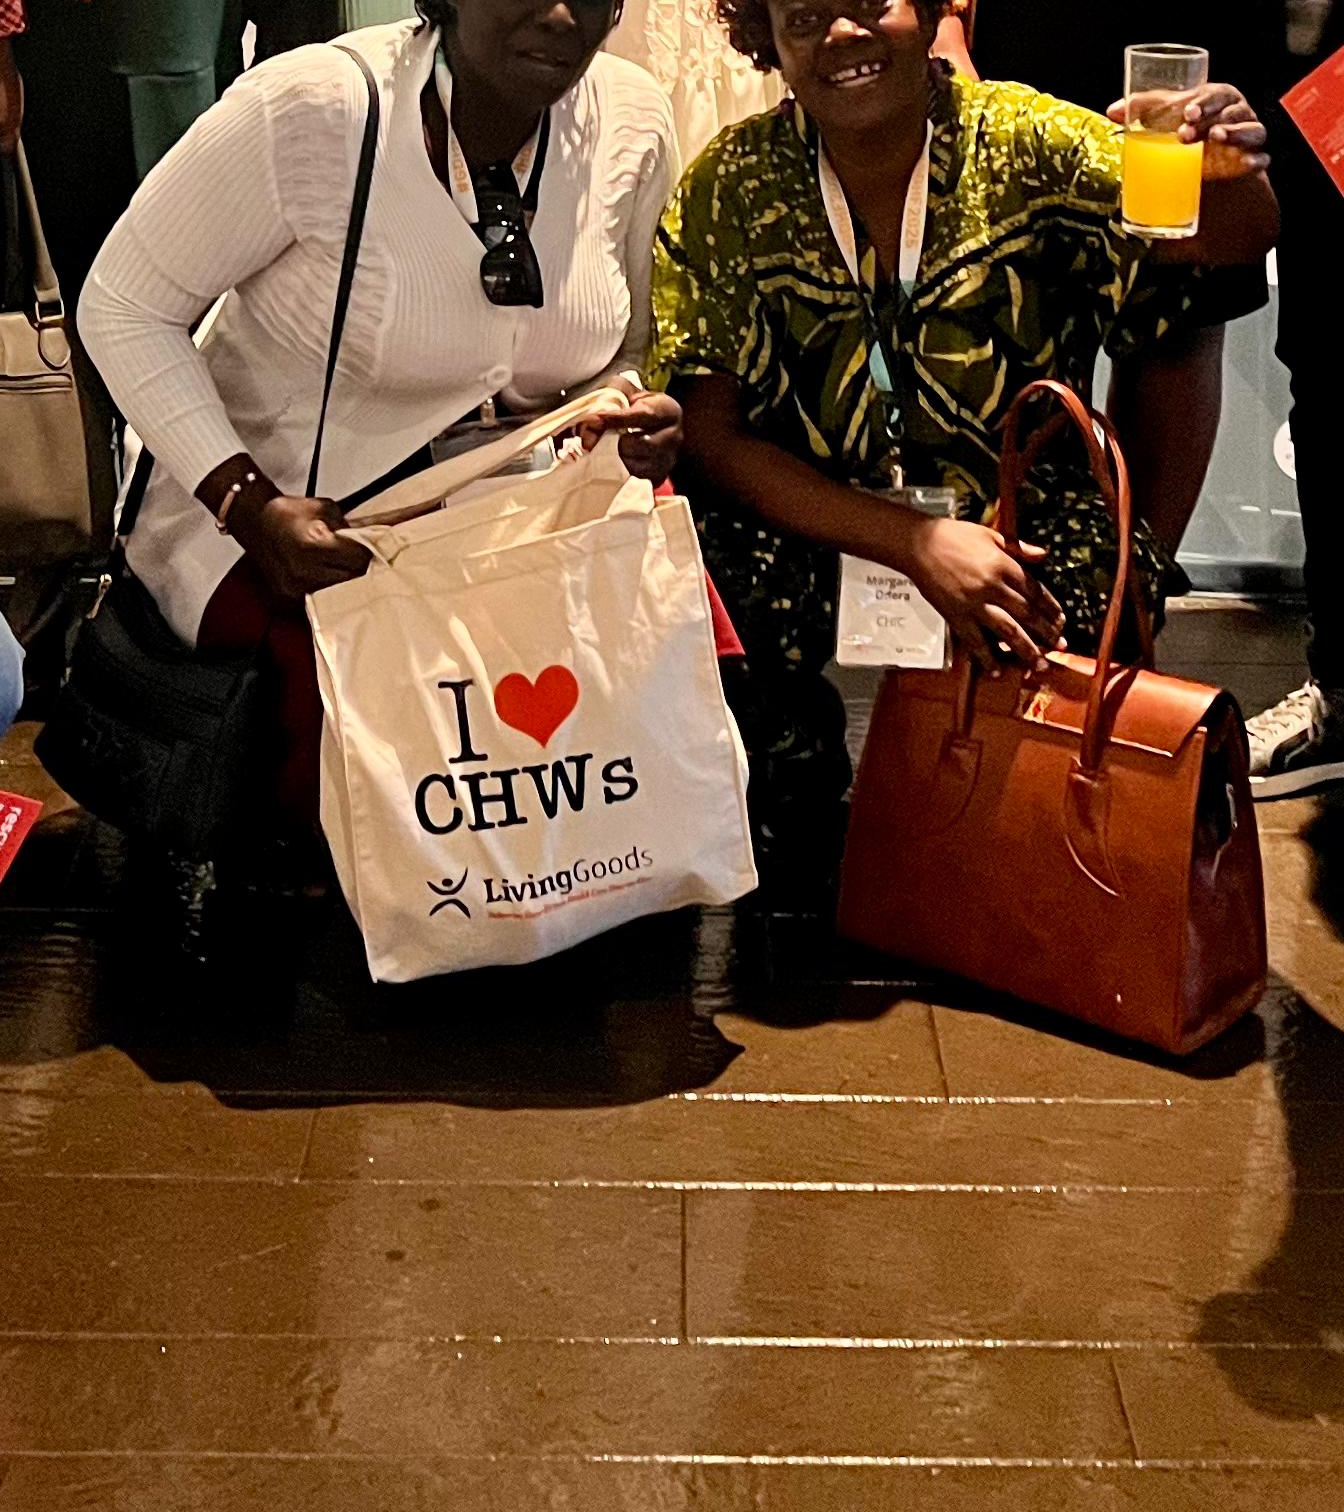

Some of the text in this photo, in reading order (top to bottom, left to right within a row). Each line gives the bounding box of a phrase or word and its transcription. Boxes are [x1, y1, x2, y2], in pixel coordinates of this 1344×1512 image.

[438, 678, 488, 765] I
[414, 752, 639, 836] CHWs
[484, 846, 654, 906] LivingGoods
